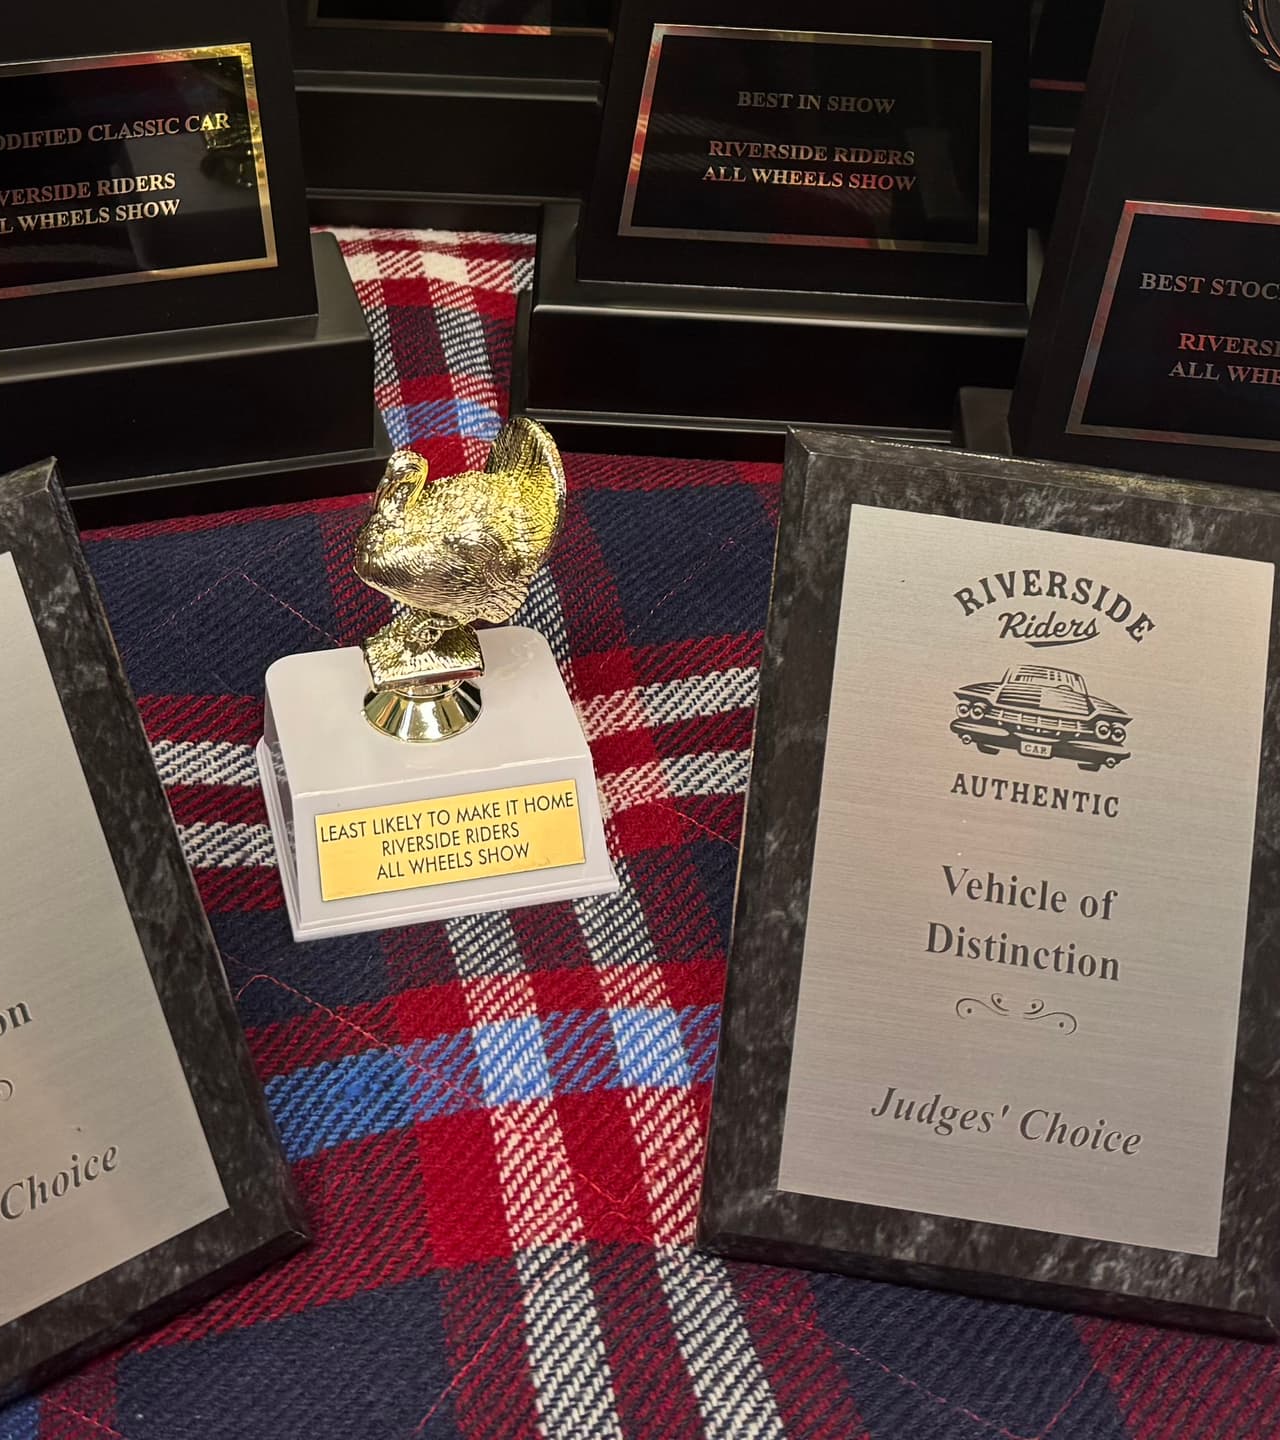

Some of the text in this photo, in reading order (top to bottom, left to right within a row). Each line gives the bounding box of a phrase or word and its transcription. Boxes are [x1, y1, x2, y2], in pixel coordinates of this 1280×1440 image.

[736, 90, 896, 114] BEST IN SHOW
[87, 117, 179, 141] CLASSIC
[184, 111, 230, 132] CAR
[708, 140, 914, 166] RIVERSIDE RIDERS
[97, 172, 176, 194] RIDERS
[702, 165, 916, 191] ALL WHEELS SHOW
[19, 208, 109, 231] WHEELS
[115, 198, 180, 220] SHOW
[1139, 272, 1205, 293] BEST
[1168, 361, 1220, 380] ALL
[953, 569, 1155, 643] RIVERSIDE
[998, 610, 1100, 648] Riders
[1024, 743, 1048, 755] CAR
[950, 773, 1119, 818] AUTHENTIC
[320, 792, 574, 843] LEAST LIKELY TO MAKE IT HOME
[382, 823, 520, 857] RIVERSIDE RIDERS
[376, 843, 530, 880] ALL WHEELS SHOW
[940, 863, 1119, 921] Vehicle of
[925, 921, 1121, 981] Distinction
[871, 1086, 1143, 1156] Judges' Choice
[1, 1143, 121, 1219] Choice
